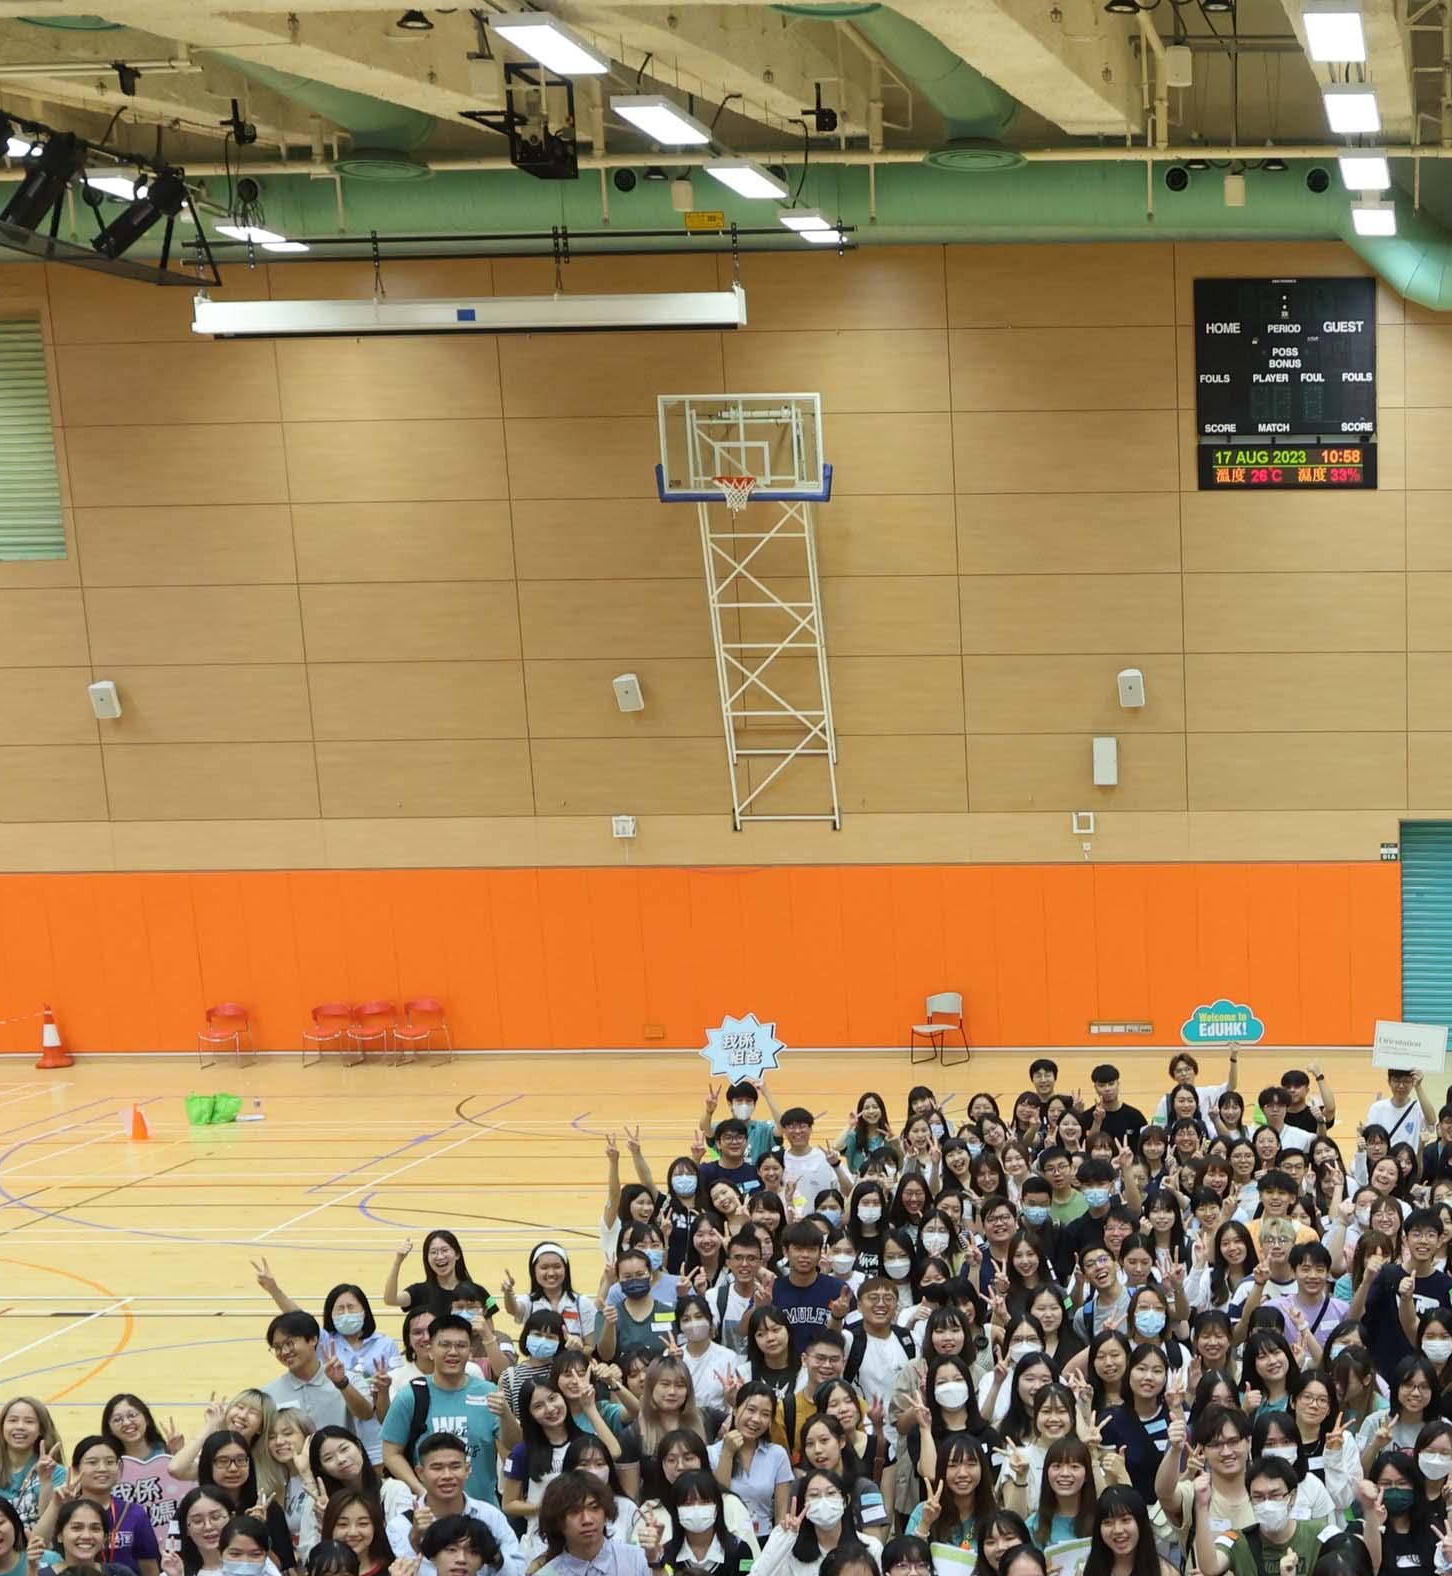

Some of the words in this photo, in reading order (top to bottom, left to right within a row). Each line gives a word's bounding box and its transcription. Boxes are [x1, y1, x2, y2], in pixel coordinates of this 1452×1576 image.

[1206, 323, 1241, 334] HOME
[1268, 324, 1301, 334] PERIOD
[1323, 321, 1364, 333] GUEST
[1272, 347, 1298, 356] POSS
[1269, 359, 1301, 368] BONUS
[1200, 374, 1230, 383] FOULS
[1253, 374, 1288, 383] PLAYER
[1300, 373, 1325, 382] FOUL
[1342, 372, 1372, 382] FOULS
[1205, 424, 1236, 433] SCORE
[1258, 423, 1290, 432] MATCH
[1341, 422, 1373, 431] SCORE
[1216, 452, 1232, 464] 17
[1236, 451, 1269, 464] AUG
[1273, 451, 1307, 464] 2023
[1321, 450, 1361, 463] 10:58
[1199, 1012, 1236, 1022] Welcome
[1238, 1012, 1247, 1021] to
[1199, 1021, 1247, 1037] EdUHK!
